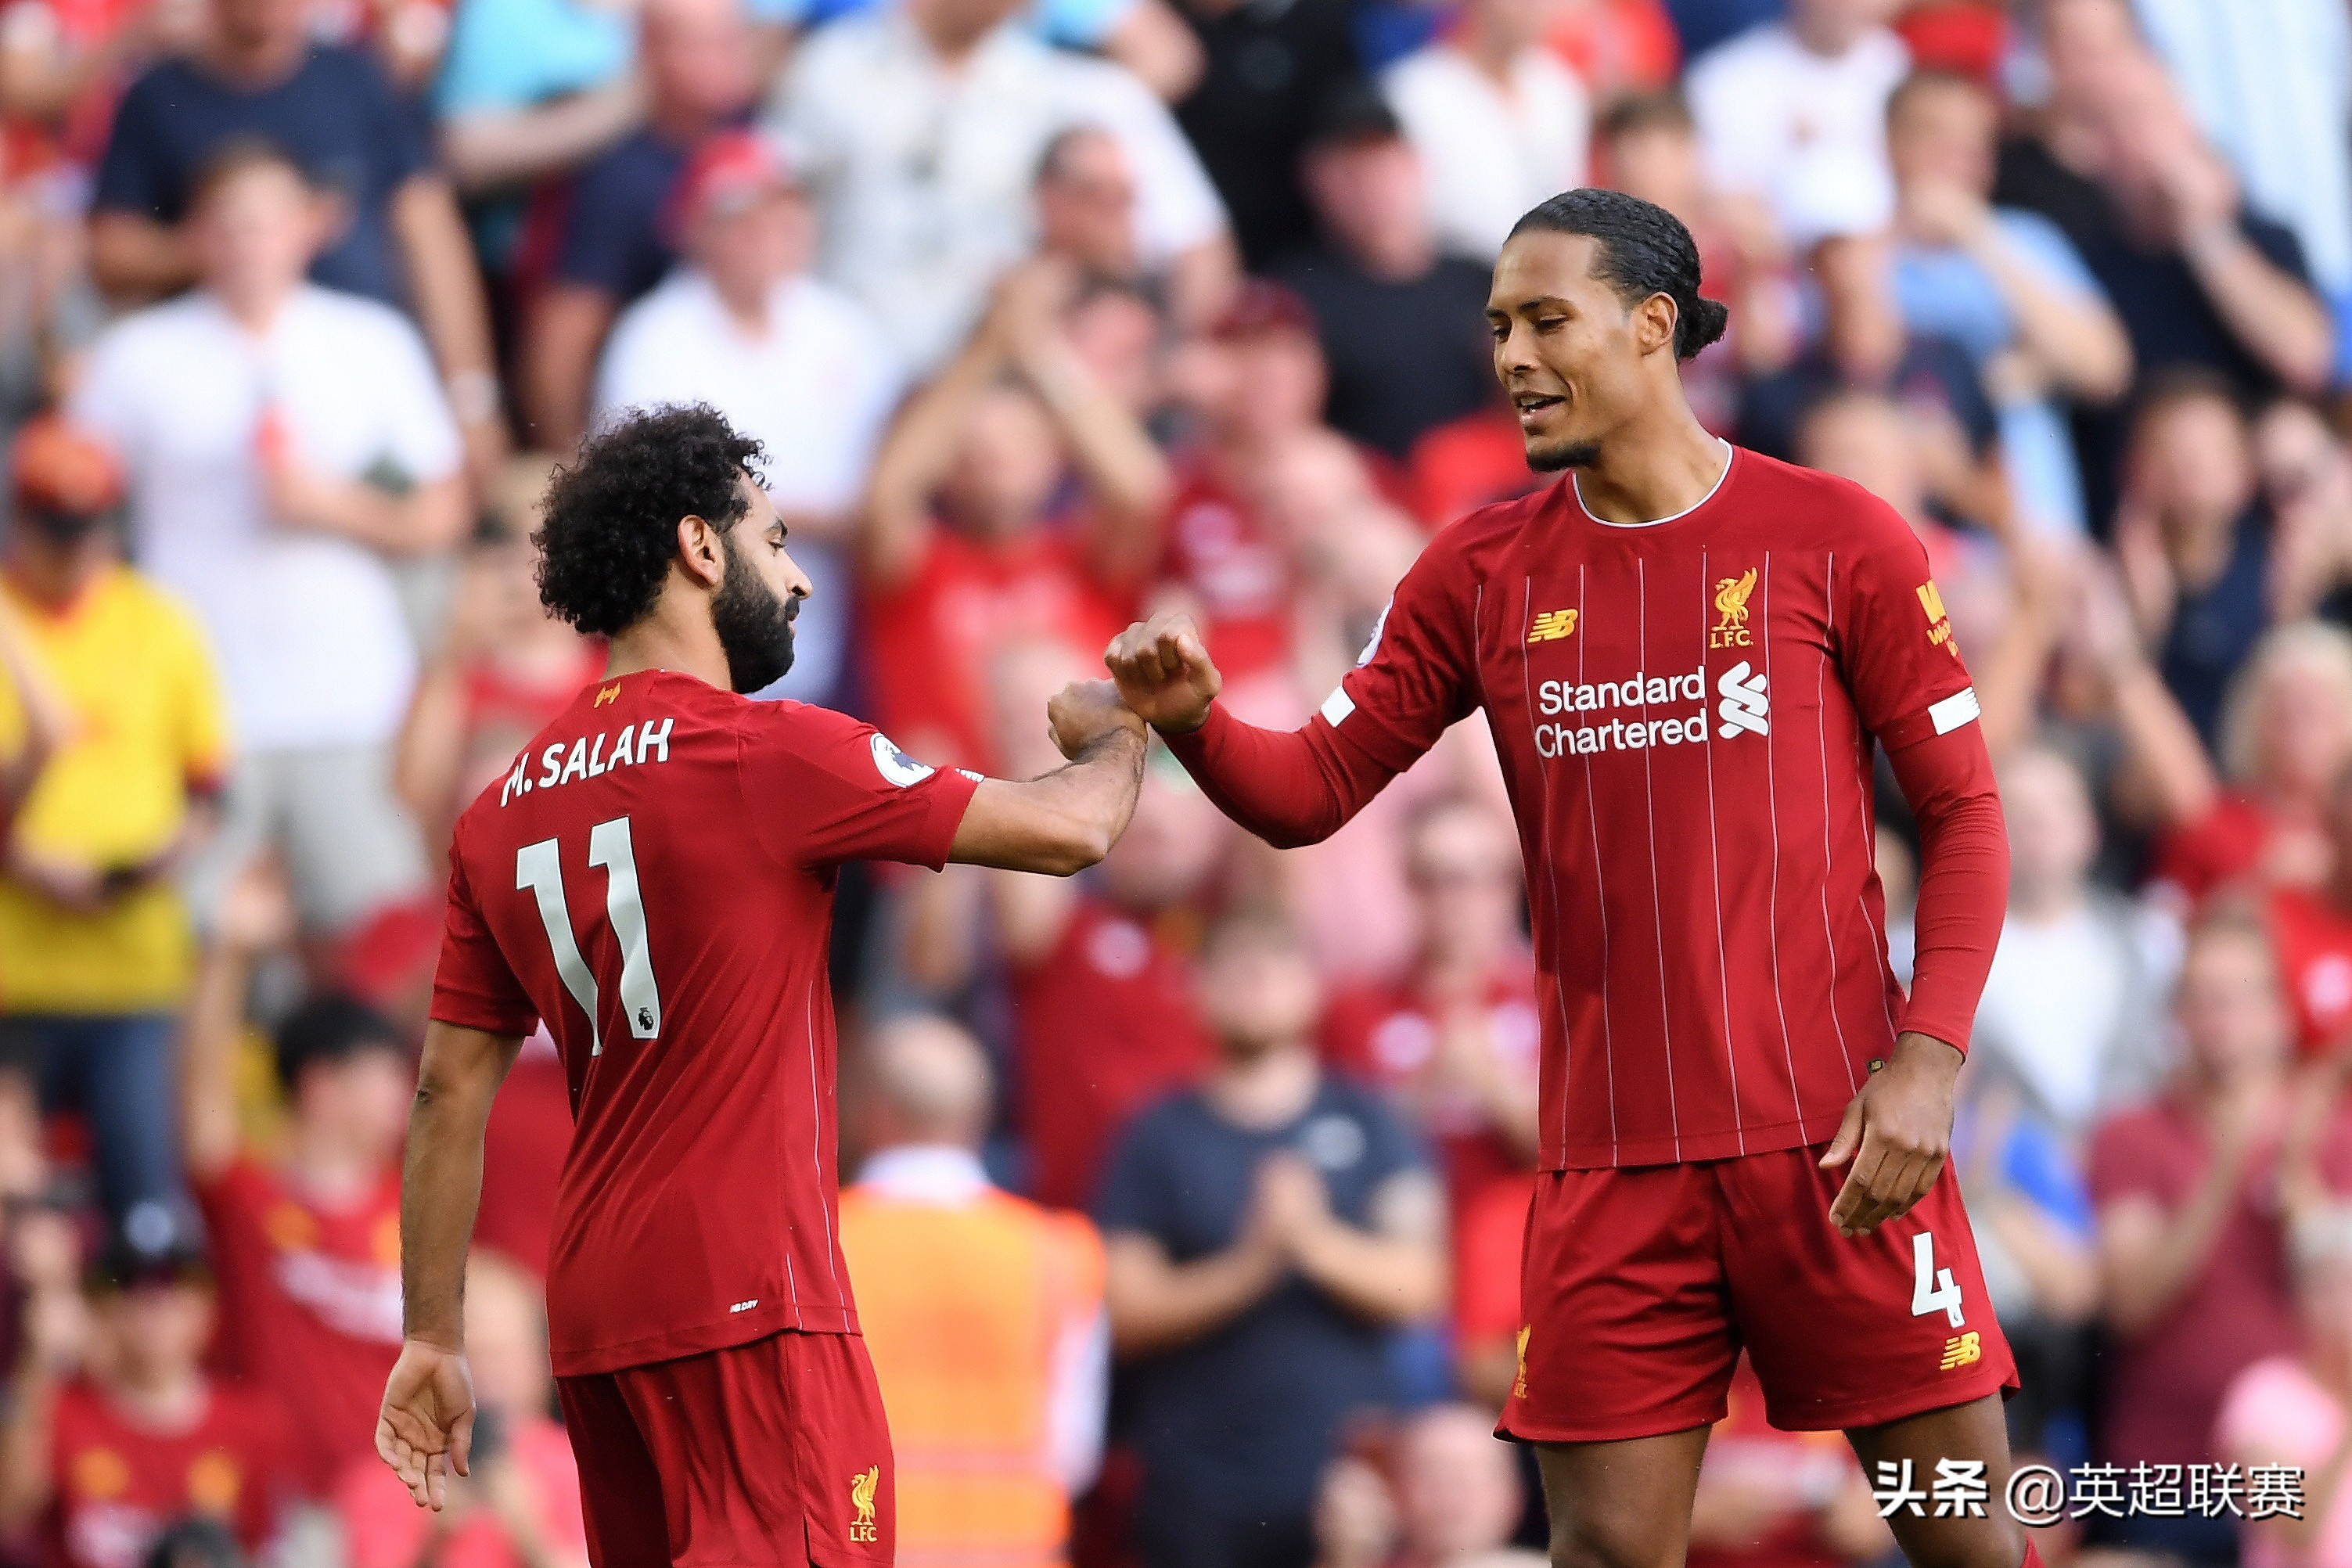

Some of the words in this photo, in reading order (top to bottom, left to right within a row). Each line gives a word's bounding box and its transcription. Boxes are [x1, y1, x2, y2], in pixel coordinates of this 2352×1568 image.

[1538, 665, 1706, 715] Standard
[1534, 707, 1709, 759] Chartered
[515, 815, 663, 1058] 11
[1911, 1231, 1965, 1329] 4
